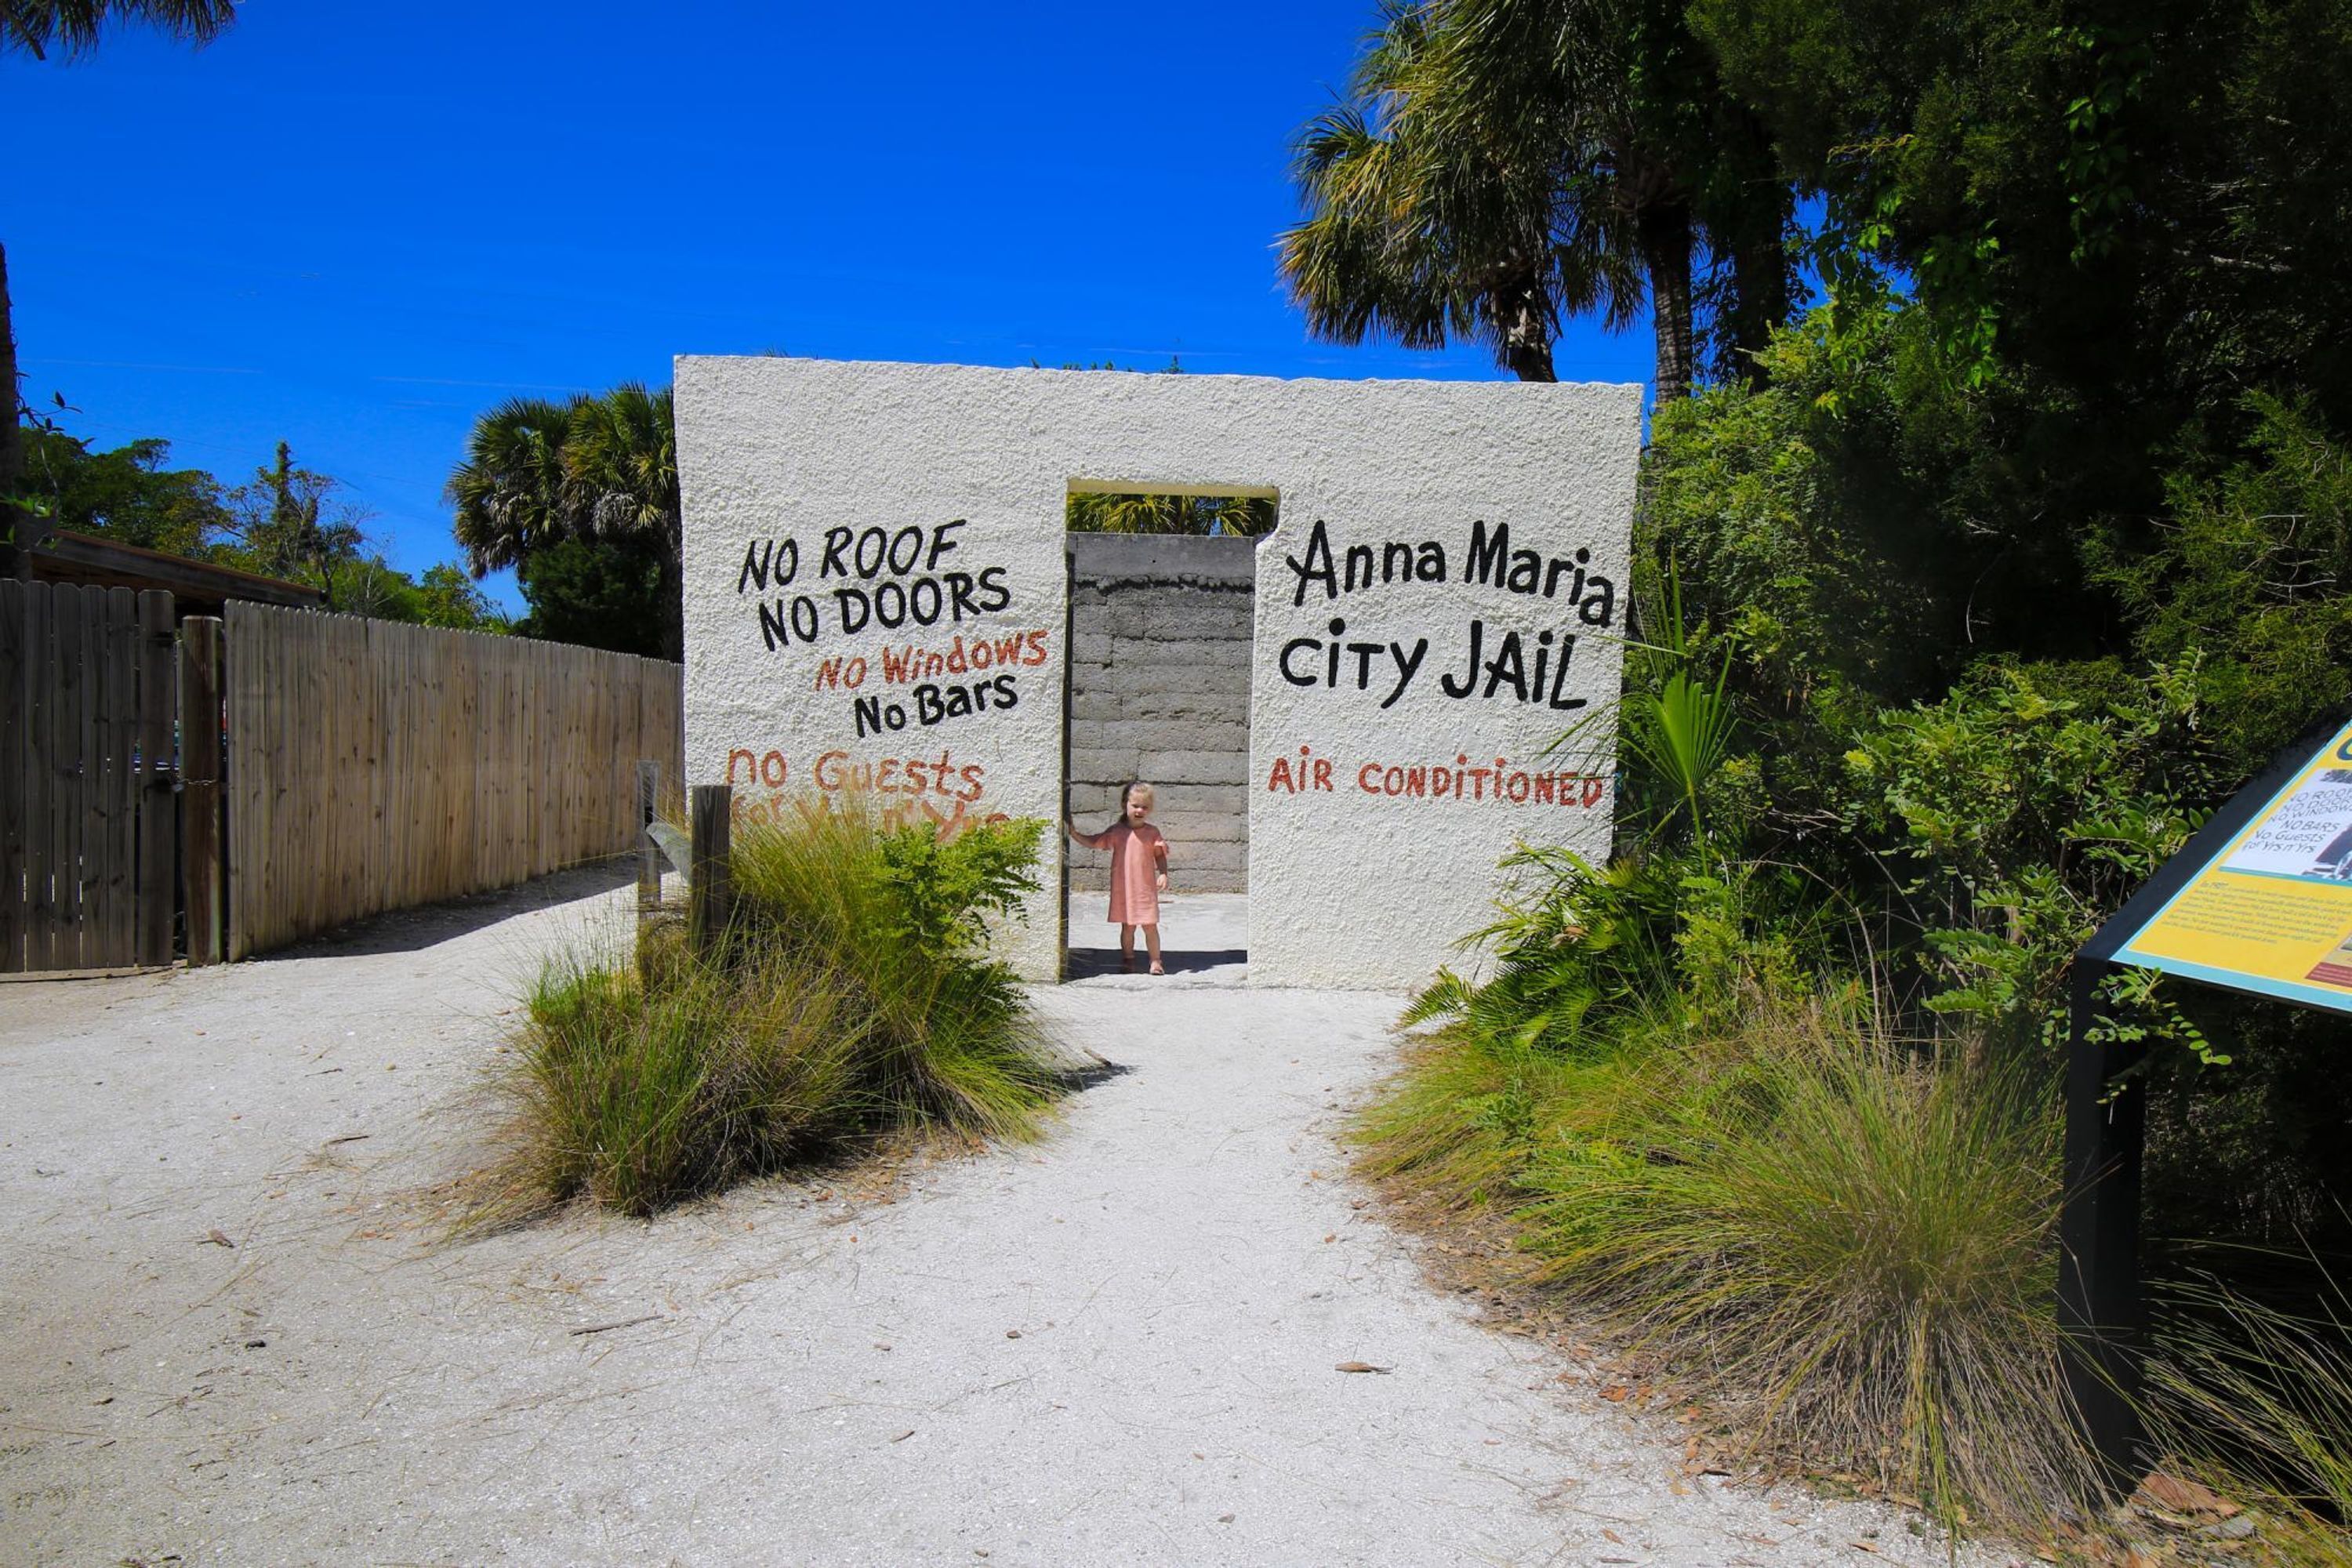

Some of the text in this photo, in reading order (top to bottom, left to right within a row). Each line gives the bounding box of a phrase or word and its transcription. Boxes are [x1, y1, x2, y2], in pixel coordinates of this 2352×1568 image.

[738, 518, 967, 593] NO ROOF
[1286, 520, 1614, 627] Anna Maria
[758, 566, 1011, 652] NO DOORS
[815, 656, 867, 691] NO
[854, 674, 1018, 738] No Bars
